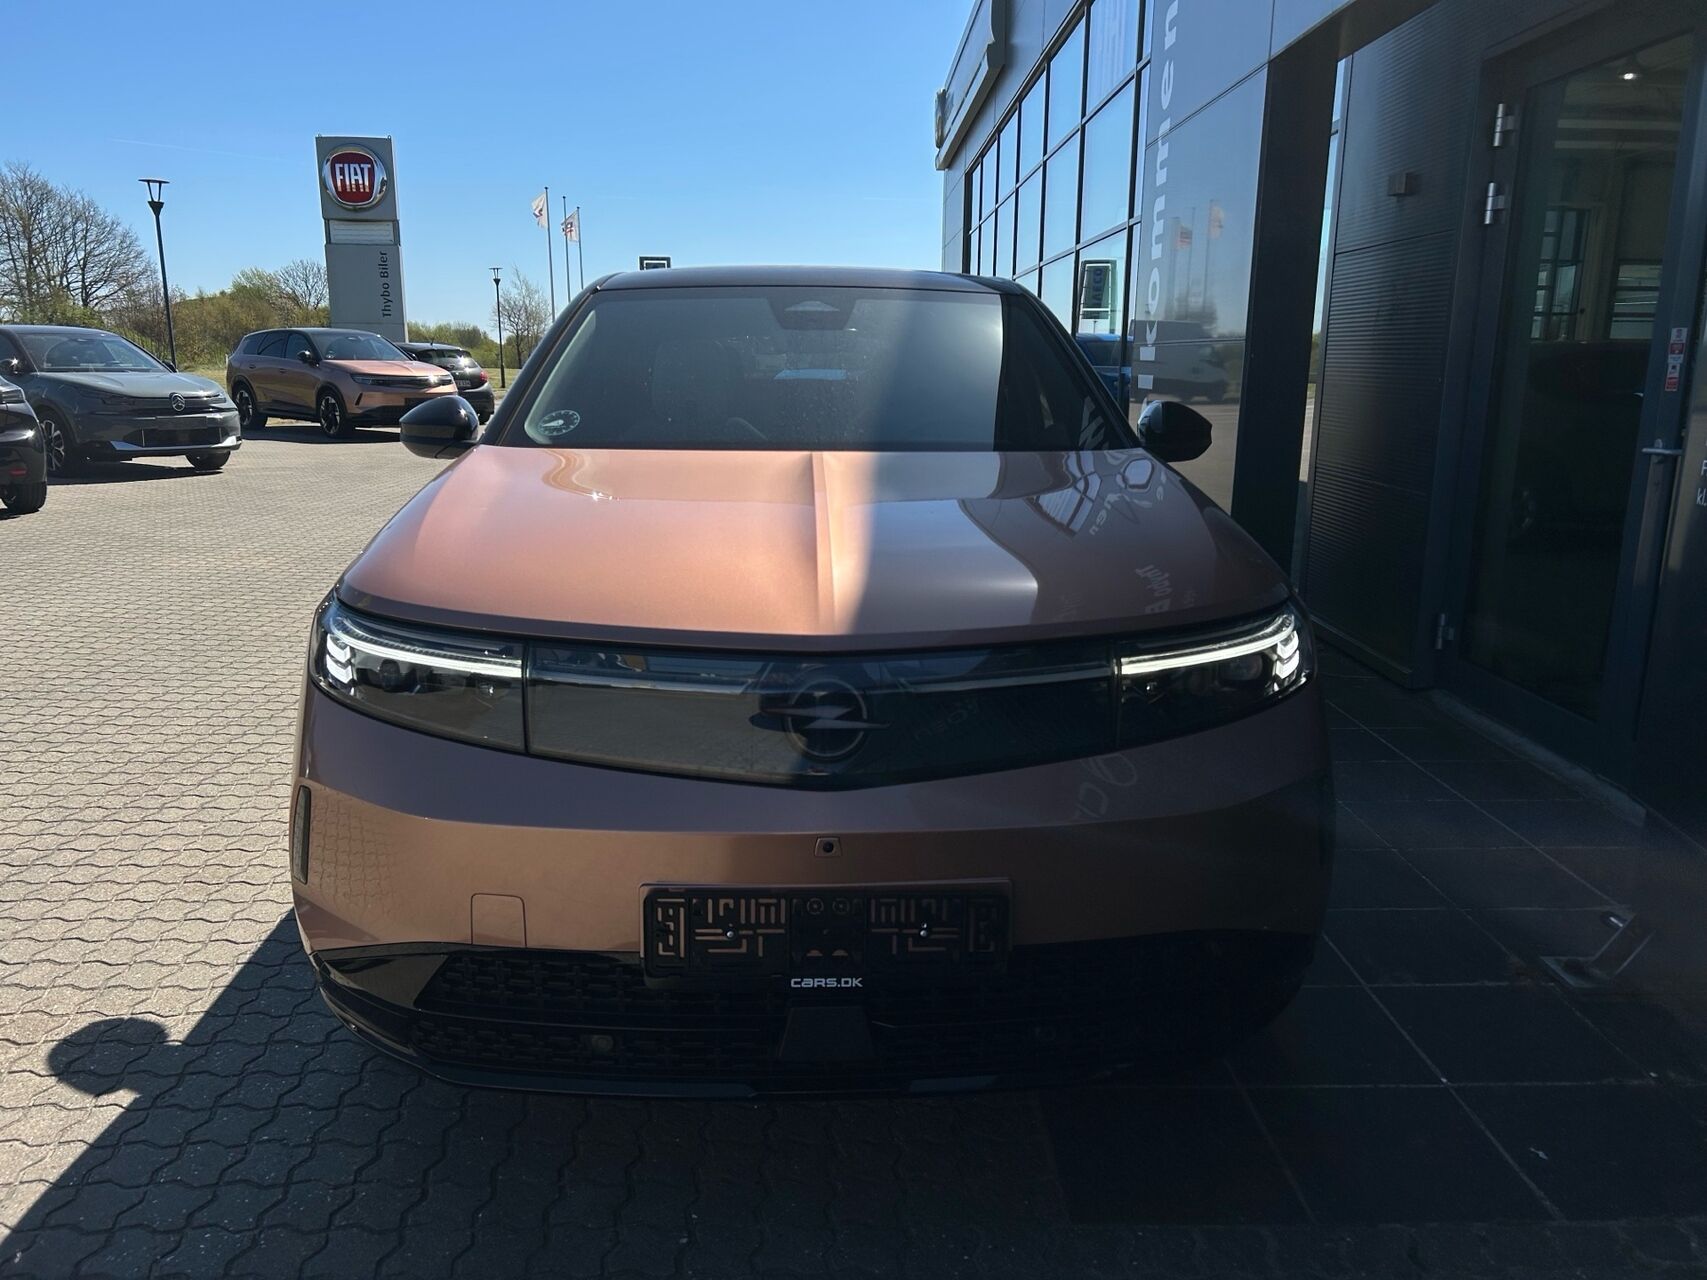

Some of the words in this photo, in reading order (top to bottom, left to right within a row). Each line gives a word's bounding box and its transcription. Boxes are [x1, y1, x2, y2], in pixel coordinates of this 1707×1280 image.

[335, 163, 371, 192] FIAT
[378, 250, 389, 278] Biler
[381, 282, 393, 318] Thybo
